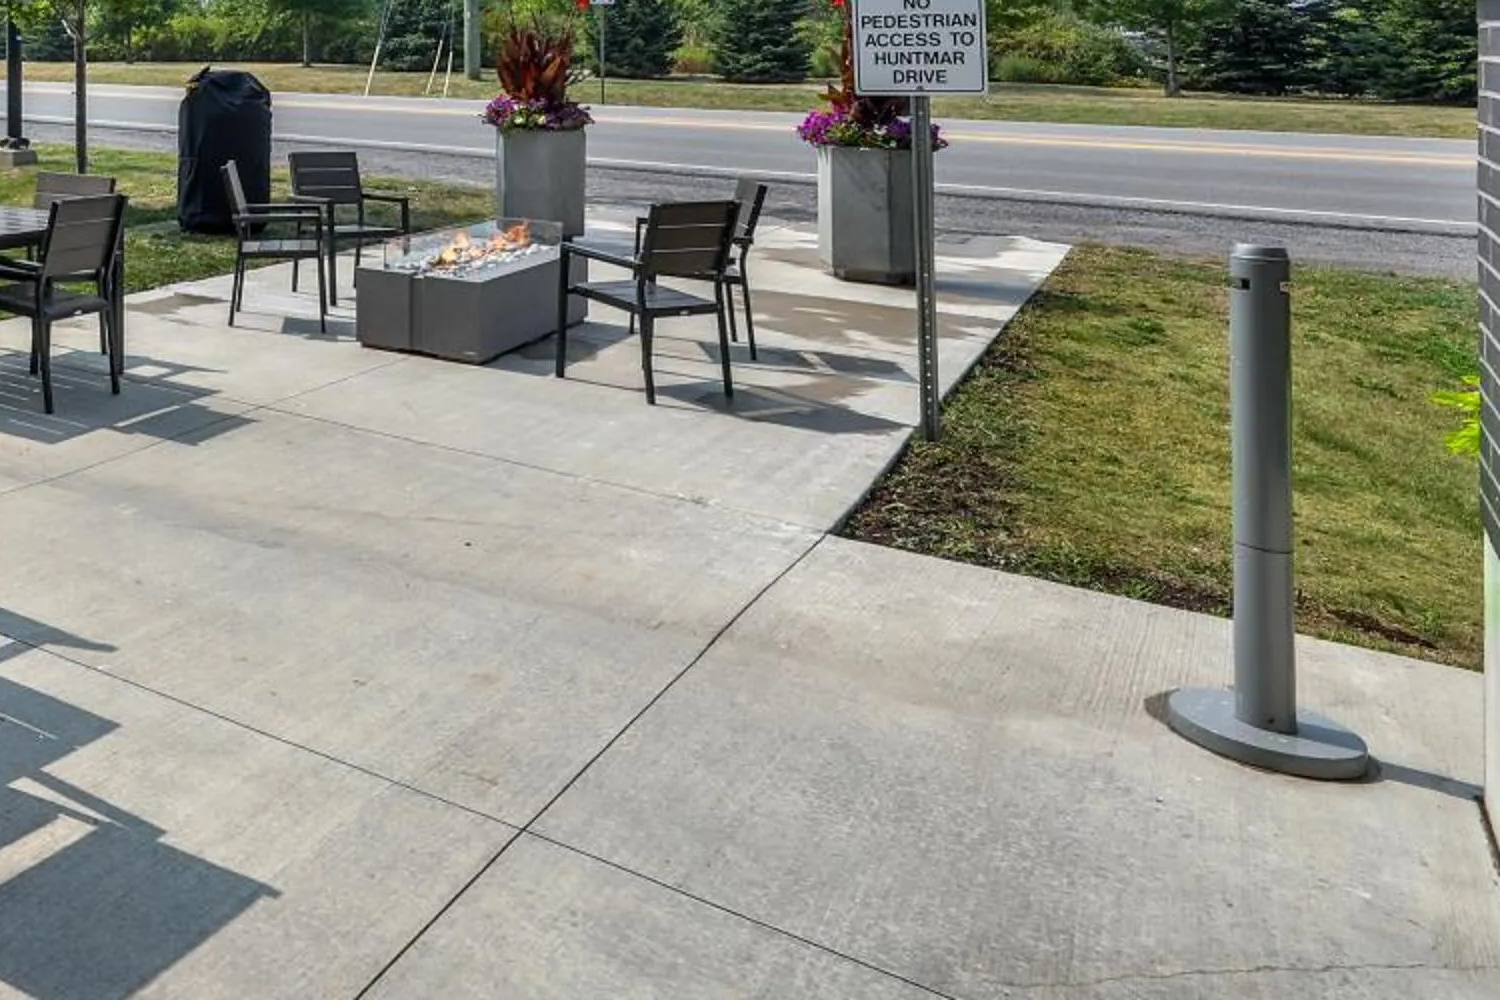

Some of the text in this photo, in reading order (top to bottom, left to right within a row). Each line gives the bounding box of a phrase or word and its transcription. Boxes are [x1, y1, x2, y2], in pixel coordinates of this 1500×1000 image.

[861, 13, 977, 29] PEDESTRIAN
[865, 31, 975, 47] ACCESS TO
[874, 51, 965, 65] HUNTMAR
[893, 69, 947, 84] DRIVE
